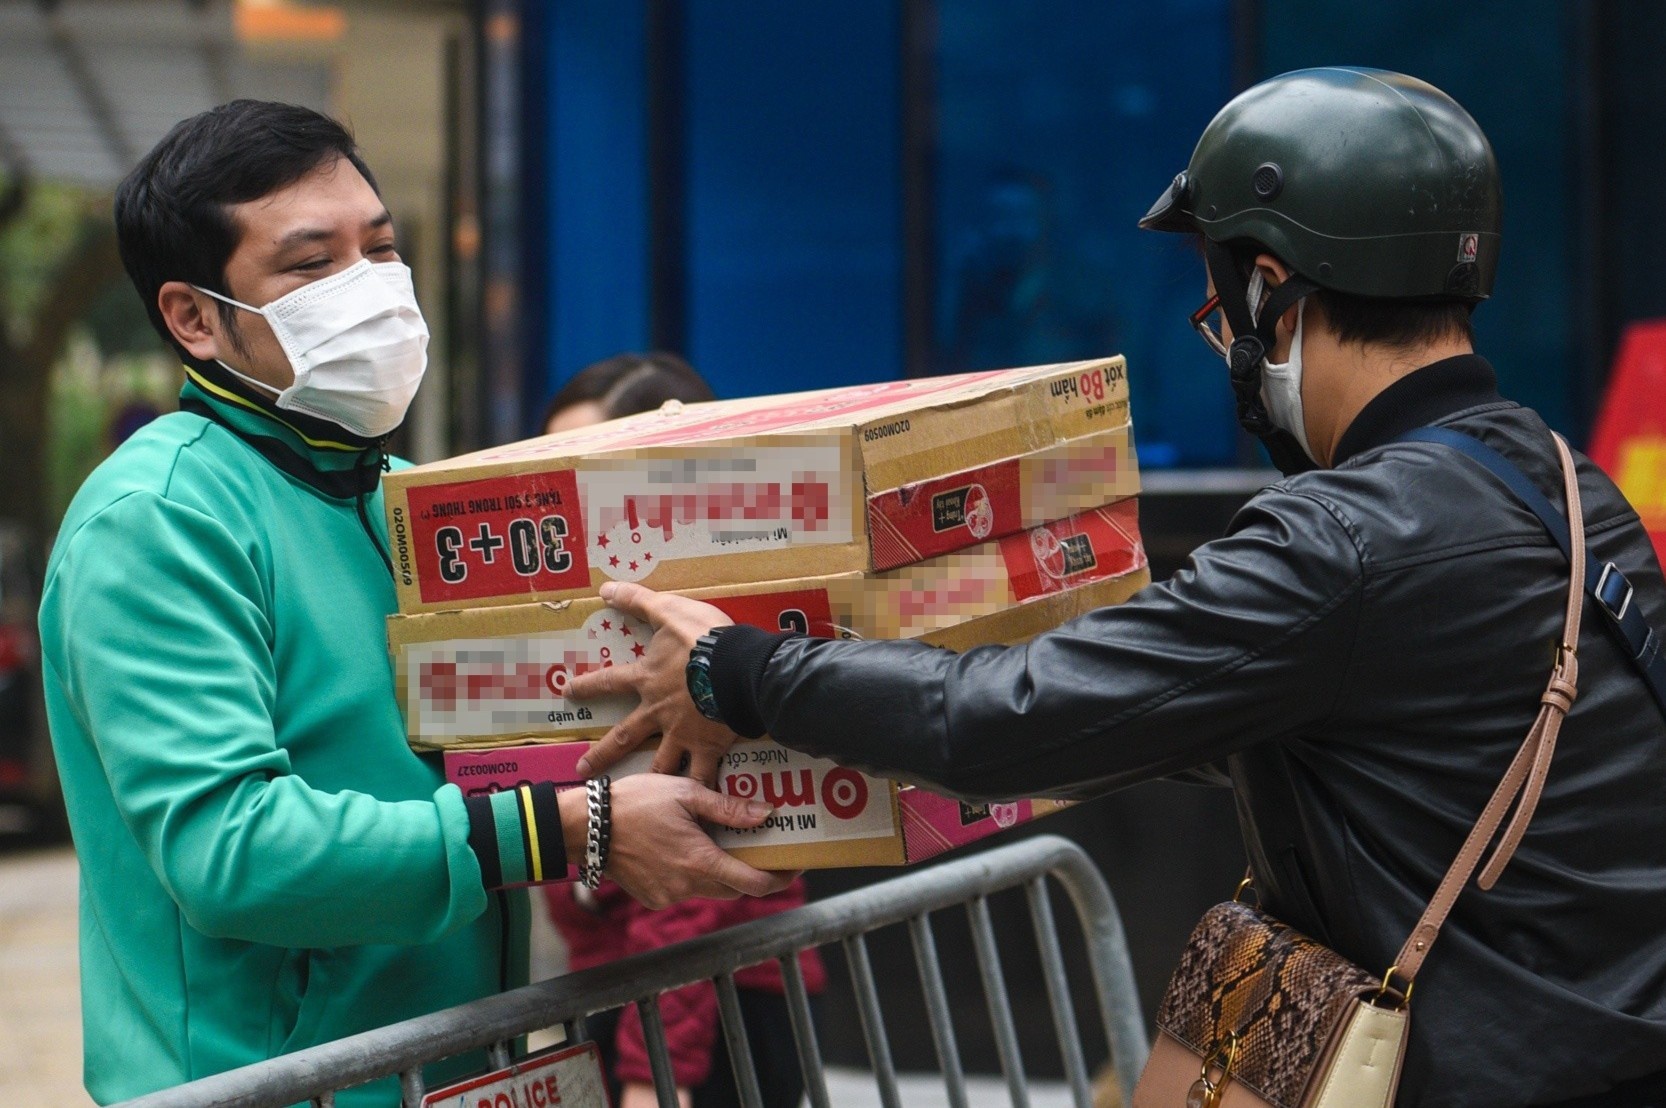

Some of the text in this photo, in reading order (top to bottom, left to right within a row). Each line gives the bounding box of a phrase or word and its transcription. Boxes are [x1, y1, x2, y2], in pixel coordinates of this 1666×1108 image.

[1080, 370, 1104, 403] Bò
[432, 501, 466, 520] THÙNG
[469, 497, 503, 515] TRONG
[435, 514, 573, 584] 30+3
[577, 707, 592, 720] đà
[752, 749, 788, 766] Nước
[717, 766, 868, 820] Oma
[797, 813, 816, 829] Mì
